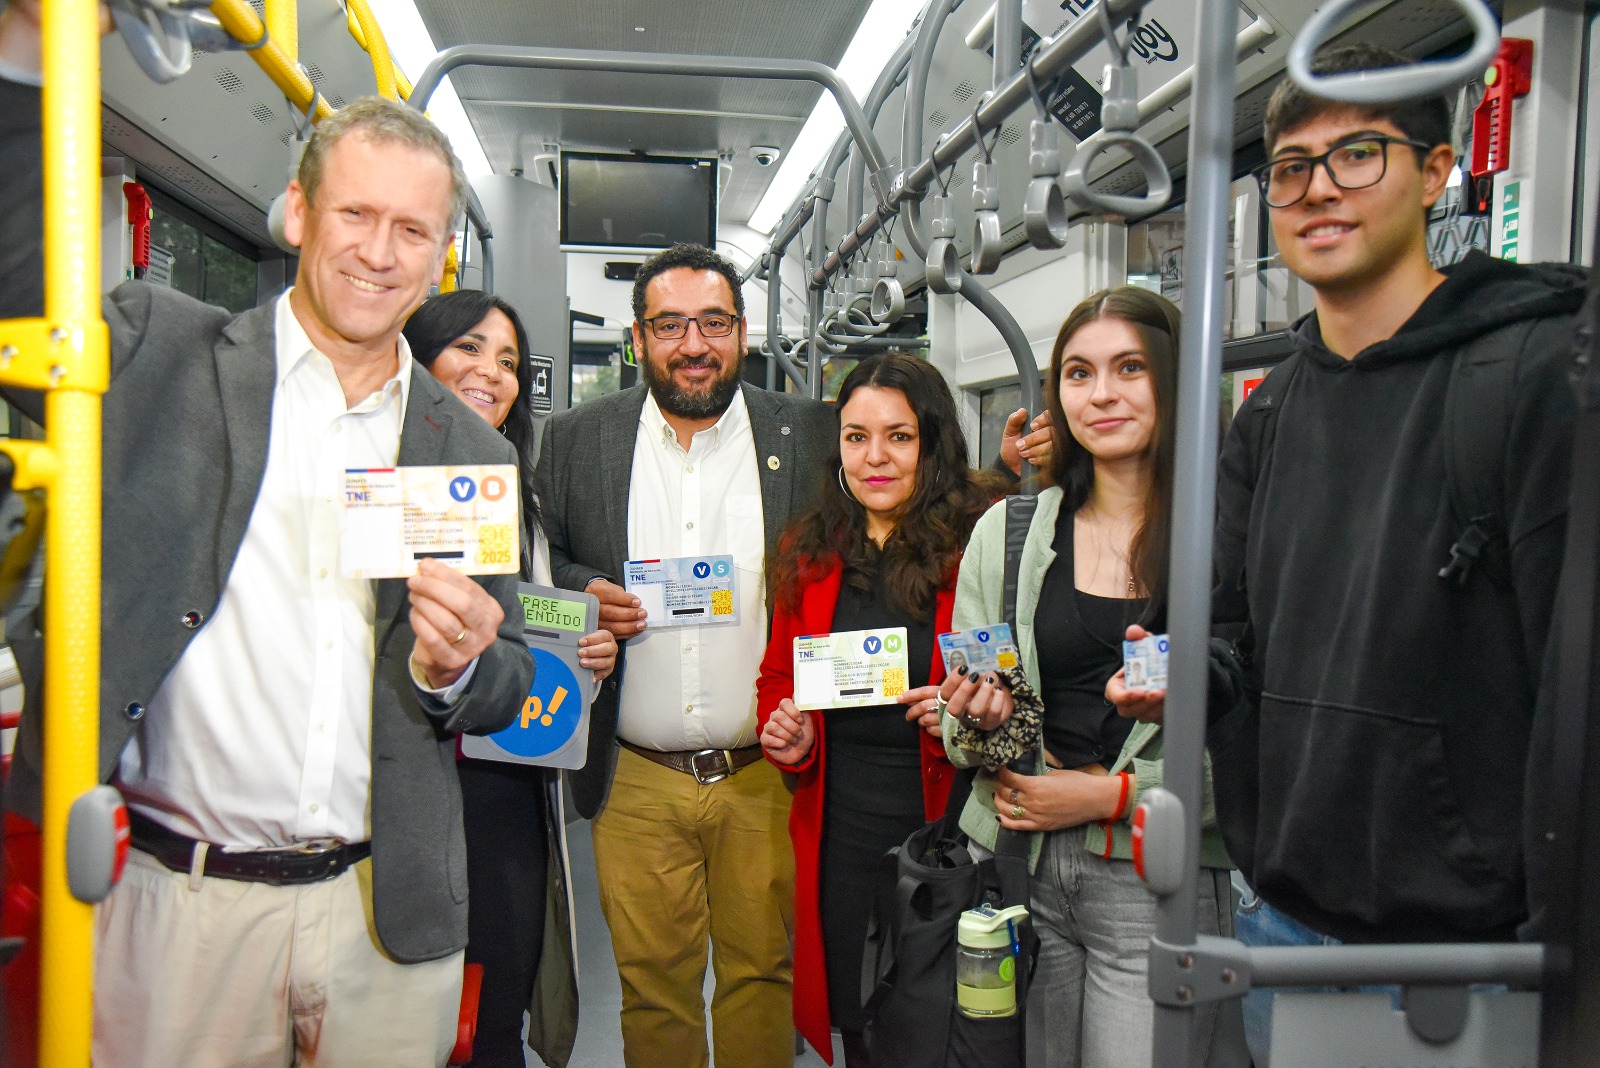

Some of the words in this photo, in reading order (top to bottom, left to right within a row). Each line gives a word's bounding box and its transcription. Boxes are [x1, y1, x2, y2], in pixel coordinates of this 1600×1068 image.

[454, 482, 470, 498] V
[487, 481, 500, 495] B
[346, 491, 371, 502] TNE
[482, 551, 511, 564] 2025
[697, 566, 707, 575] V
[718, 564, 725, 573] S
[523, 596, 558, 612] PASE
[714, 606, 732, 615] 2025
[527, 609, 580, 626] ENDIDO
[867, 640, 878, 651] V
[888, 639, 898, 648] M
[884, 687, 904, 696] 2025
[518, 685, 568, 728] p!
